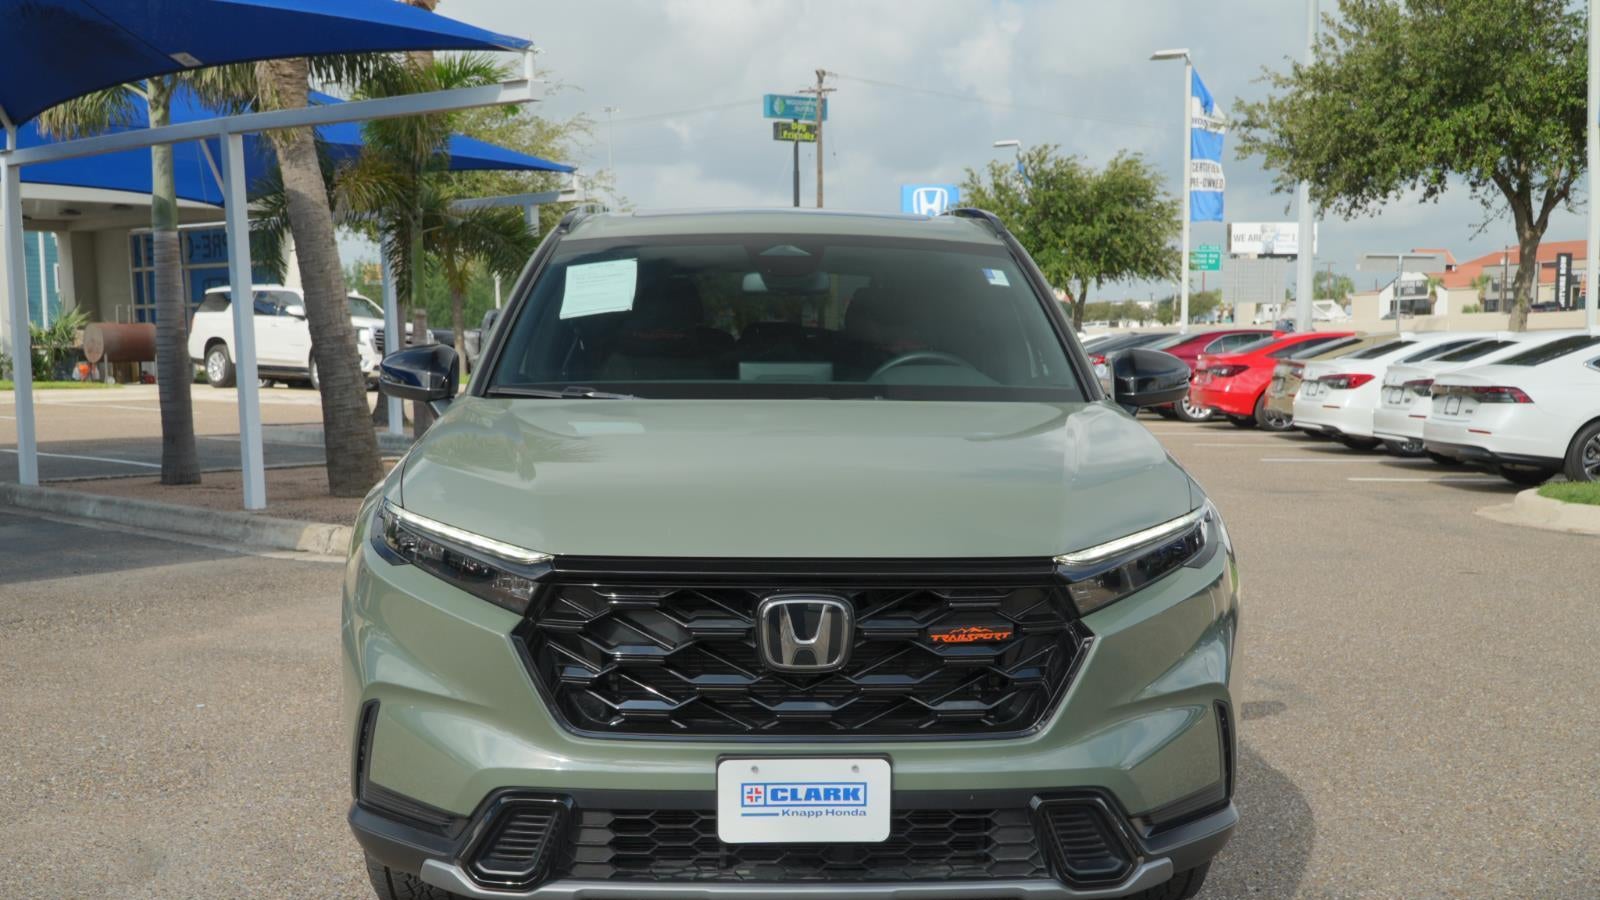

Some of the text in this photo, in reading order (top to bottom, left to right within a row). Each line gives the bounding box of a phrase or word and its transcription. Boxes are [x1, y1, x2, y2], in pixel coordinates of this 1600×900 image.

[930, 631, 1012, 643] TRAILSPORT
[770, 788, 861, 802] CLARK
[781, 809, 867, 818] Knapp Honda
